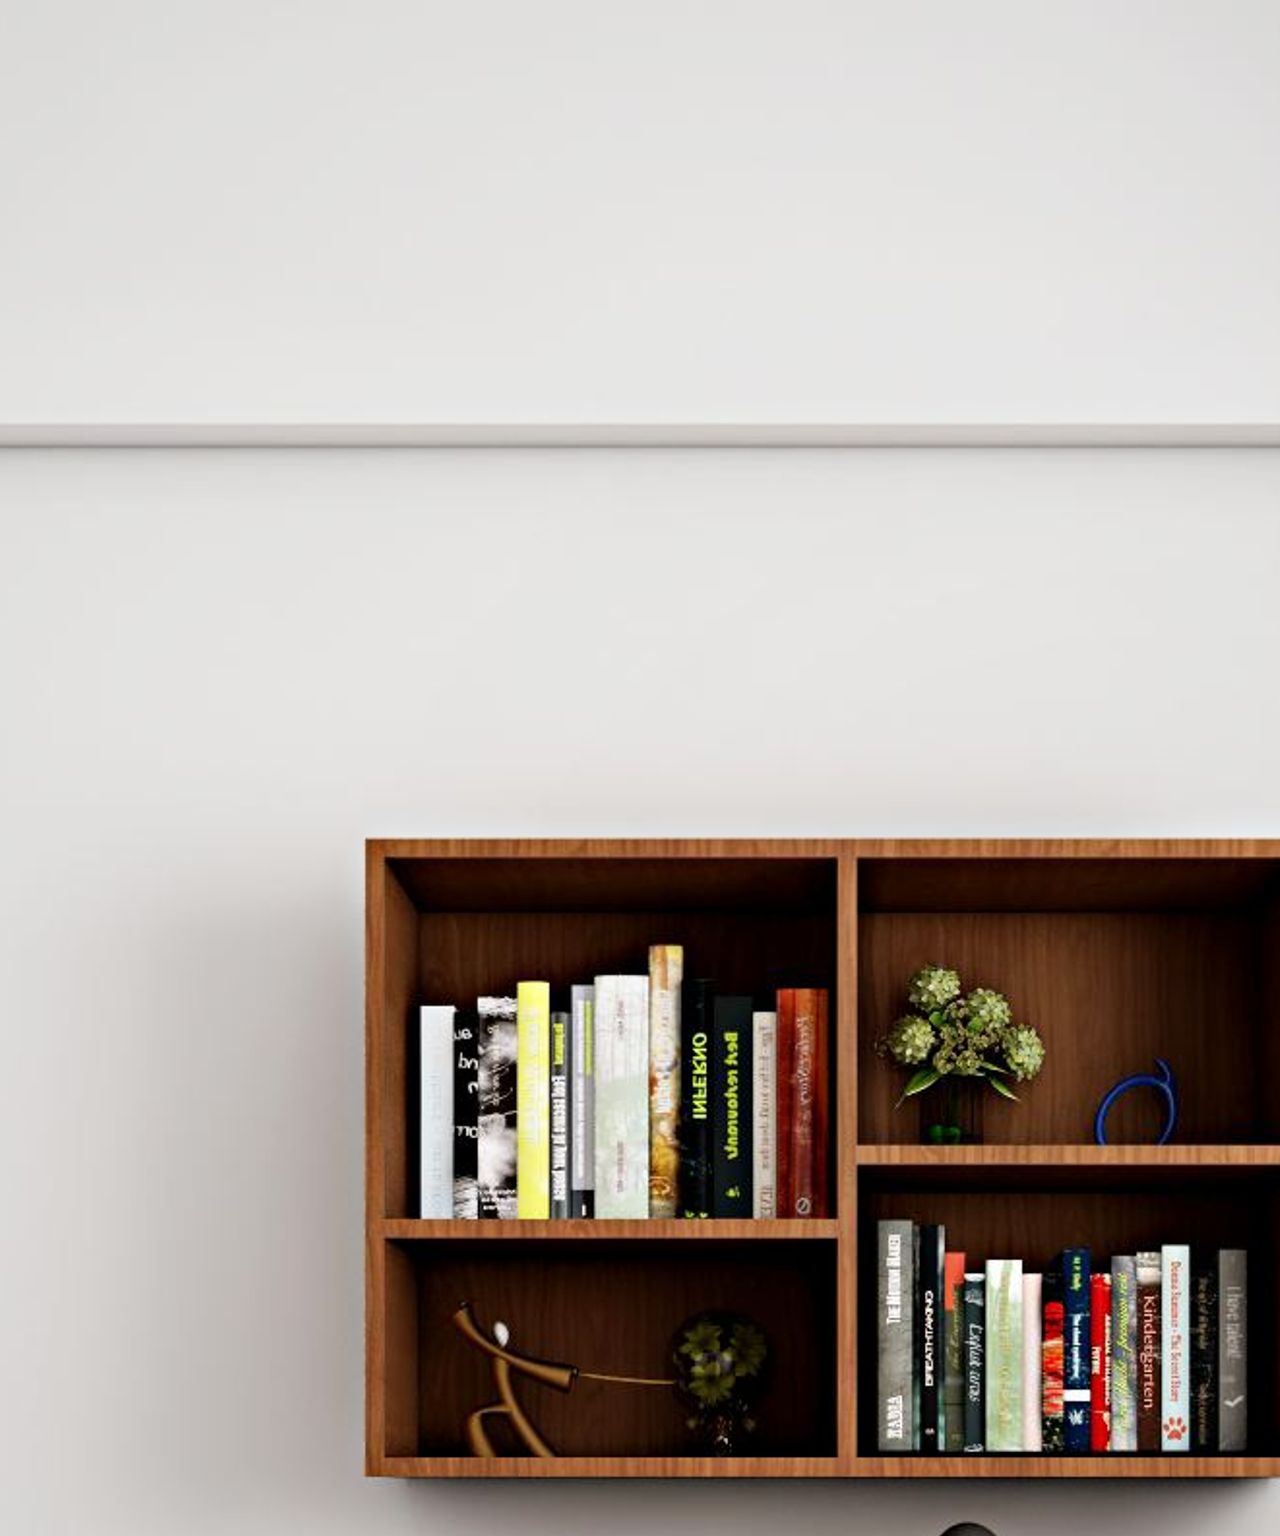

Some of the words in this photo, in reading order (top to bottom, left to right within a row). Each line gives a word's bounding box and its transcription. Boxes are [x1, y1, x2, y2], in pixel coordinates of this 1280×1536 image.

[924, 1290, 935, 1387] BREATHTAKING
[1140, 1294, 1157, 1409] Kindergarten
[1226, 1294, 1243, 1321] have
